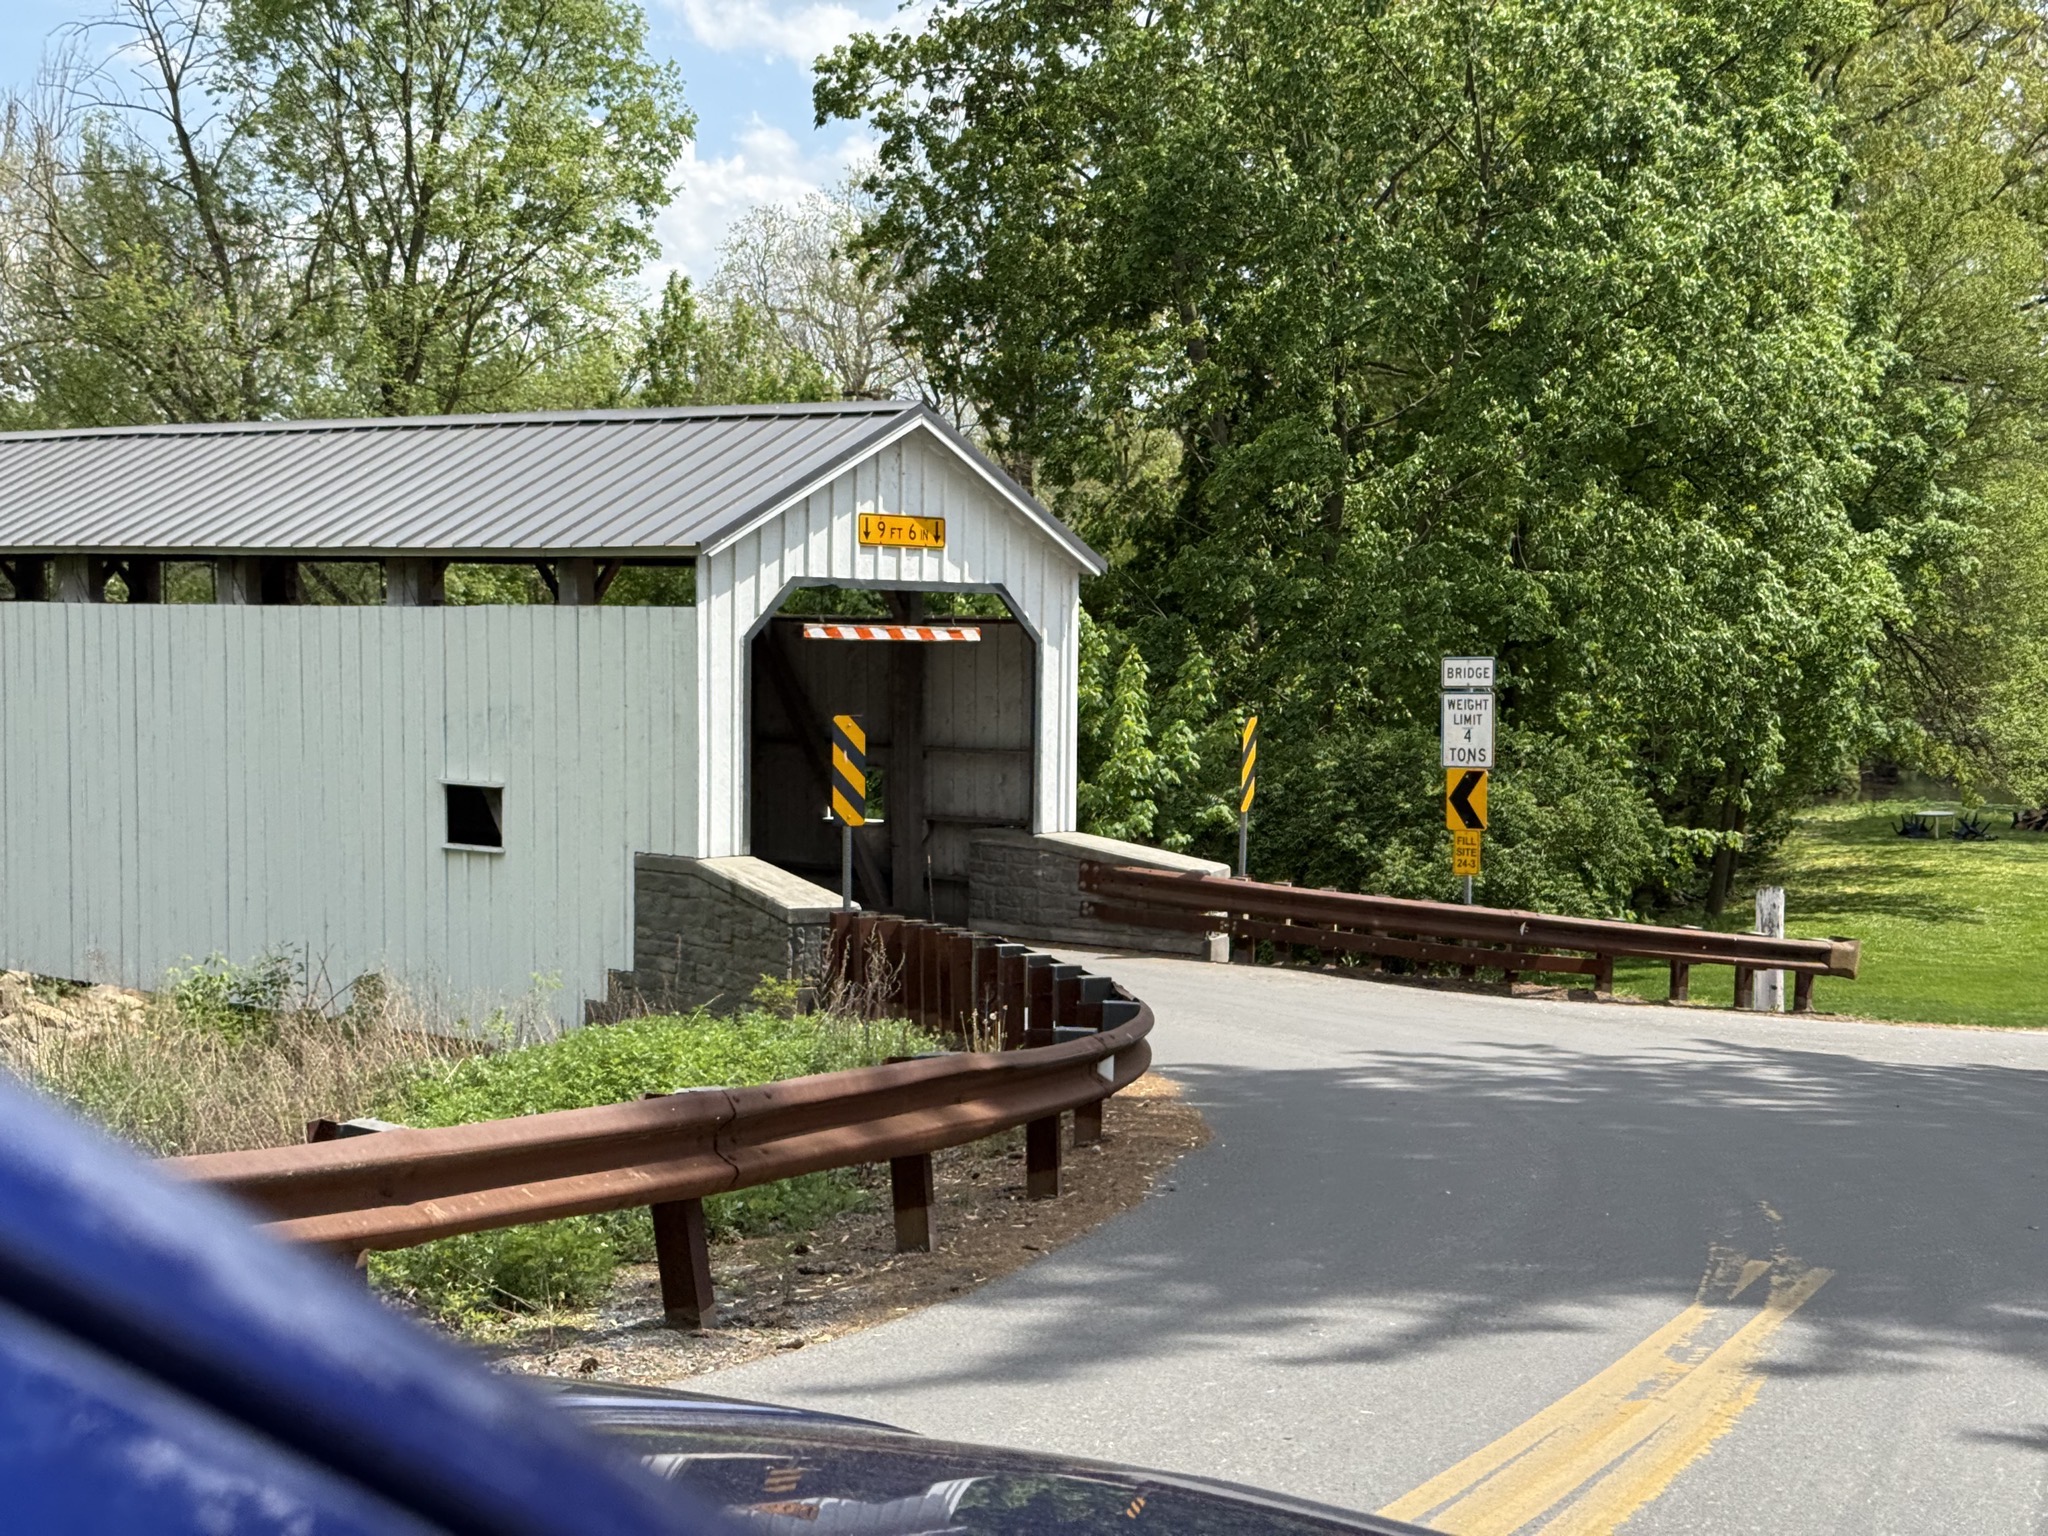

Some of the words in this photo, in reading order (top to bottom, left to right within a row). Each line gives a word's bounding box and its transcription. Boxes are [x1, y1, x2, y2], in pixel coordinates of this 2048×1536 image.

[877, 521, 886, 538] 9
[890, 527, 903, 539] FT
[908, 523, 917, 541] 6
[920, 529, 929, 541] IN
[1447, 667, 1490, 679] BRIDGE
[1447, 699, 1489, 711] WEIGHT
[1453, 714, 1482, 726] LIMIT
[1463, 729, 1472, 742] 4
[1449, 747, 1487, 762] TONS
[1456, 836, 1477, 846] FILL
[1456, 847, 1477, 857] SITE
[1456, 858, 1476, 868] 24-3
